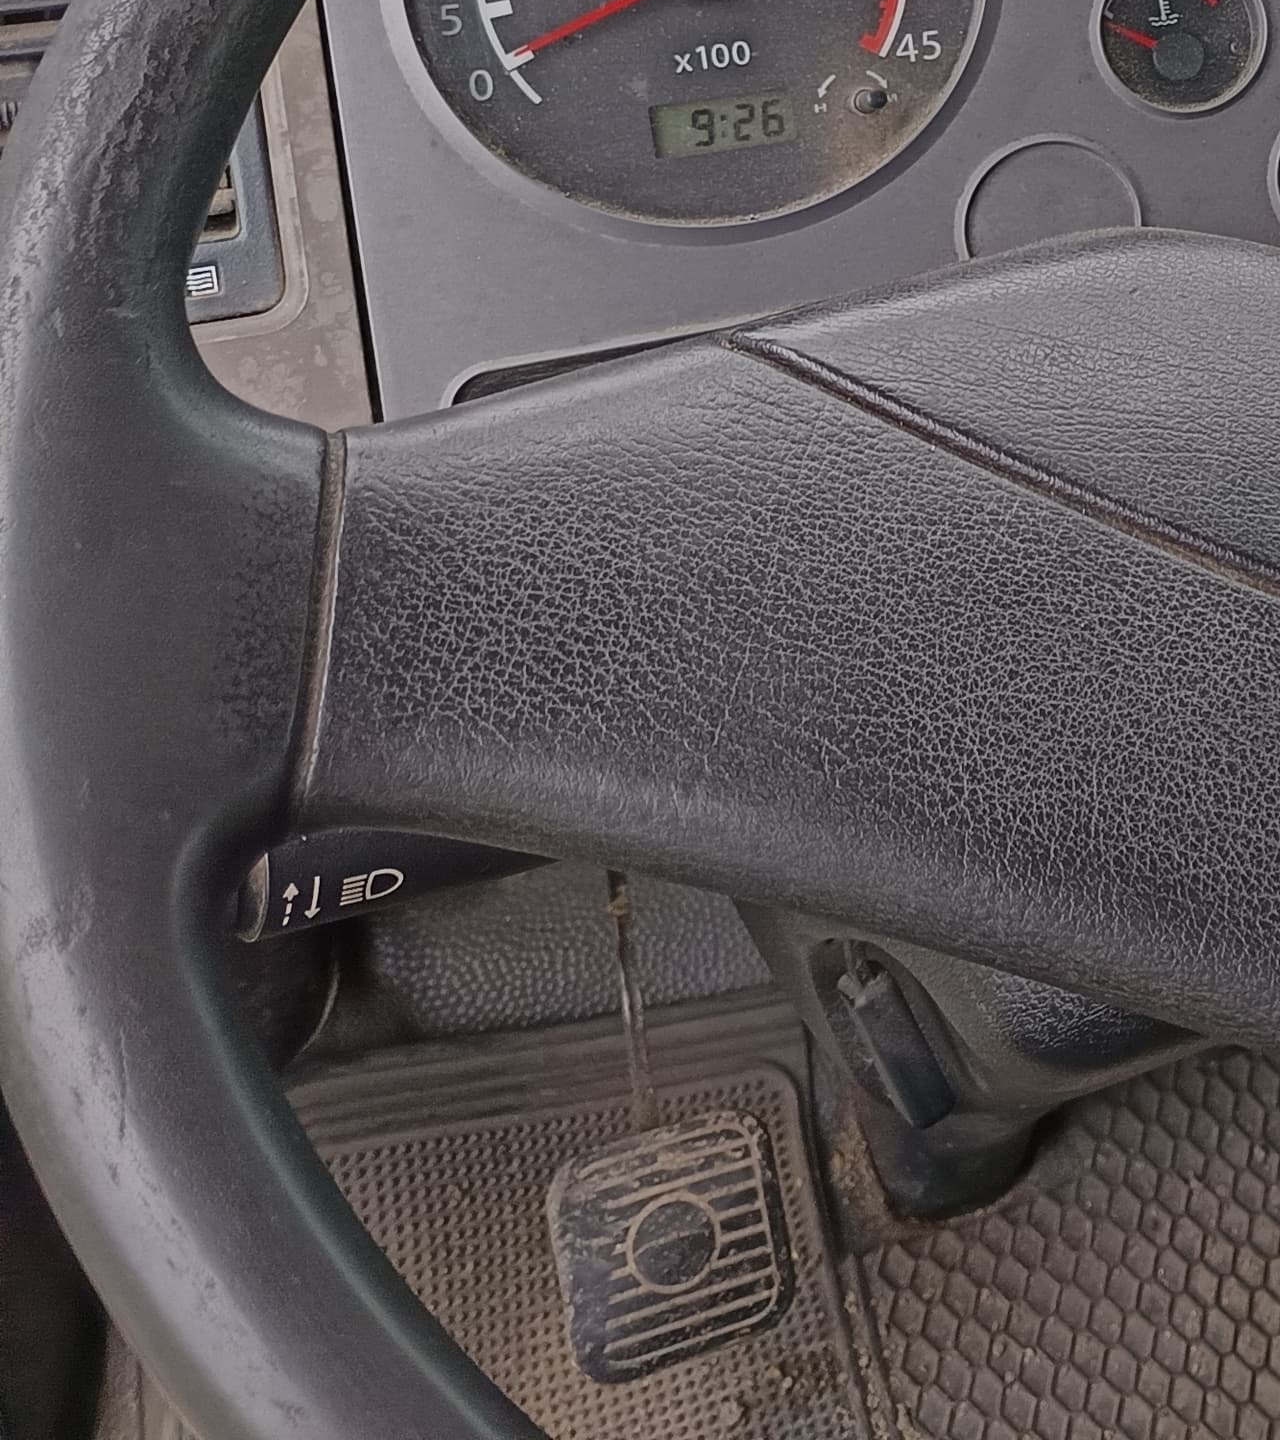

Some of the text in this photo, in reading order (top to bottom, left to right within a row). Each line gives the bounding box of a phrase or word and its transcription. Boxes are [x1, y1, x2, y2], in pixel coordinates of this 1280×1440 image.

[441, 3, 463, 36] 5
[674, 40, 751, 73] x100
[896, 32, 942, 62] 45
[469, 69, 494, 101] 0
[690, 99, 785, 147] 9:26
